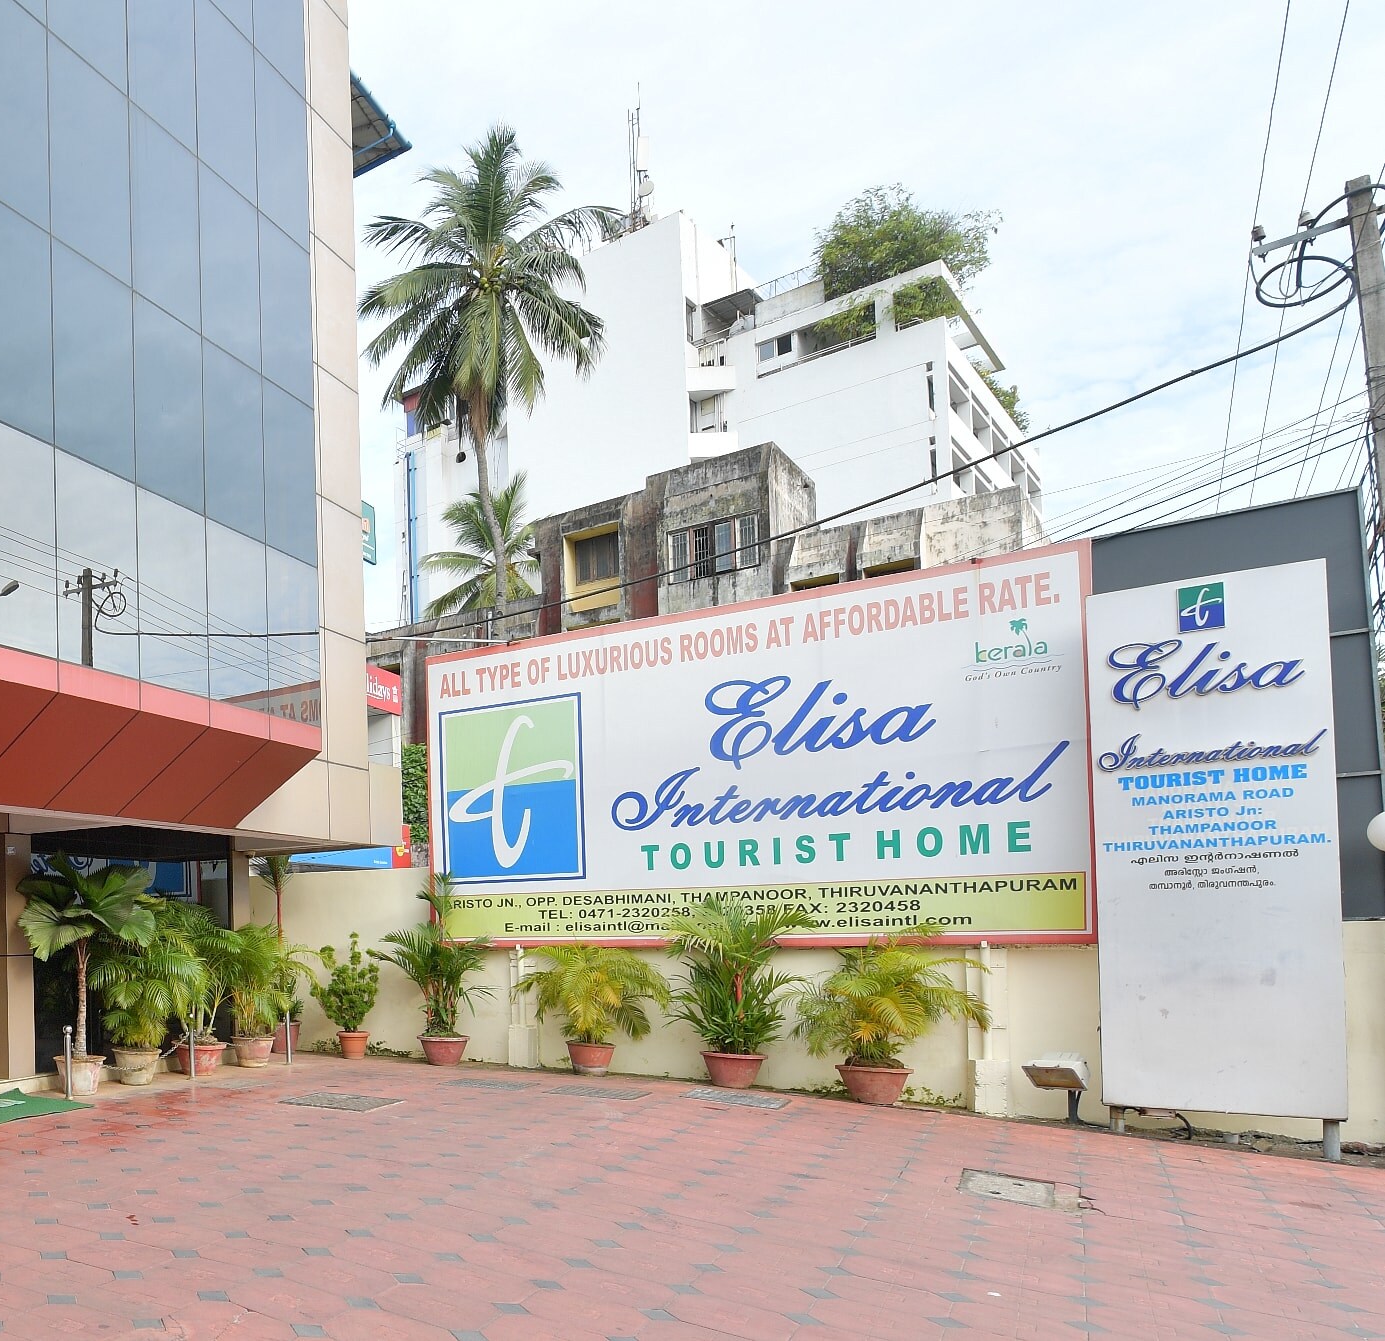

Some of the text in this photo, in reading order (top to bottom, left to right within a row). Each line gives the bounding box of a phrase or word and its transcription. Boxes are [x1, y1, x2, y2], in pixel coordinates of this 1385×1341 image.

[439, 571, 1061, 699] ALL TYPE OF LUXURIOUS ROOMS AT AFFORDABLE RATE.
[974, 634, 1049, 664] kerala
[965, 663, 1063, 682] God's Own Country
[1107, 639, 1306, 710] Elisa
[704, 675, 937, 770] Elisa
[1097, 728, 1328, 771] International
[611, 740, 1070, 832] International
[1117, 763, 1308, 791] TOURIST HOME
[1131, 787, 1295, 807] MANORAMA ROAD
[1162, 805, 1263, 820] ARISTO Jn:
[1148, 819, 1277, 836] THAMPANOOR
[641, 820, 1032, 870] TOURIST HOME
[1102, 833, 1332, 853] THIRUVANANTHAPURAM.
[497, 897, 522, 910] JN.,
[526, 896, 557, 908] OPP.
[562, 892, 676, 908] DESABHIMANI,
[818, 877, 1078, 899] THIRUVANANTHAPURAM
[538, 909, 573, 920] TEL:
[578, 905, 696, 919] 0471-2320258,
[836, 899, 922, 914] 2320458
[504, 920, 551, 932] E-mail
